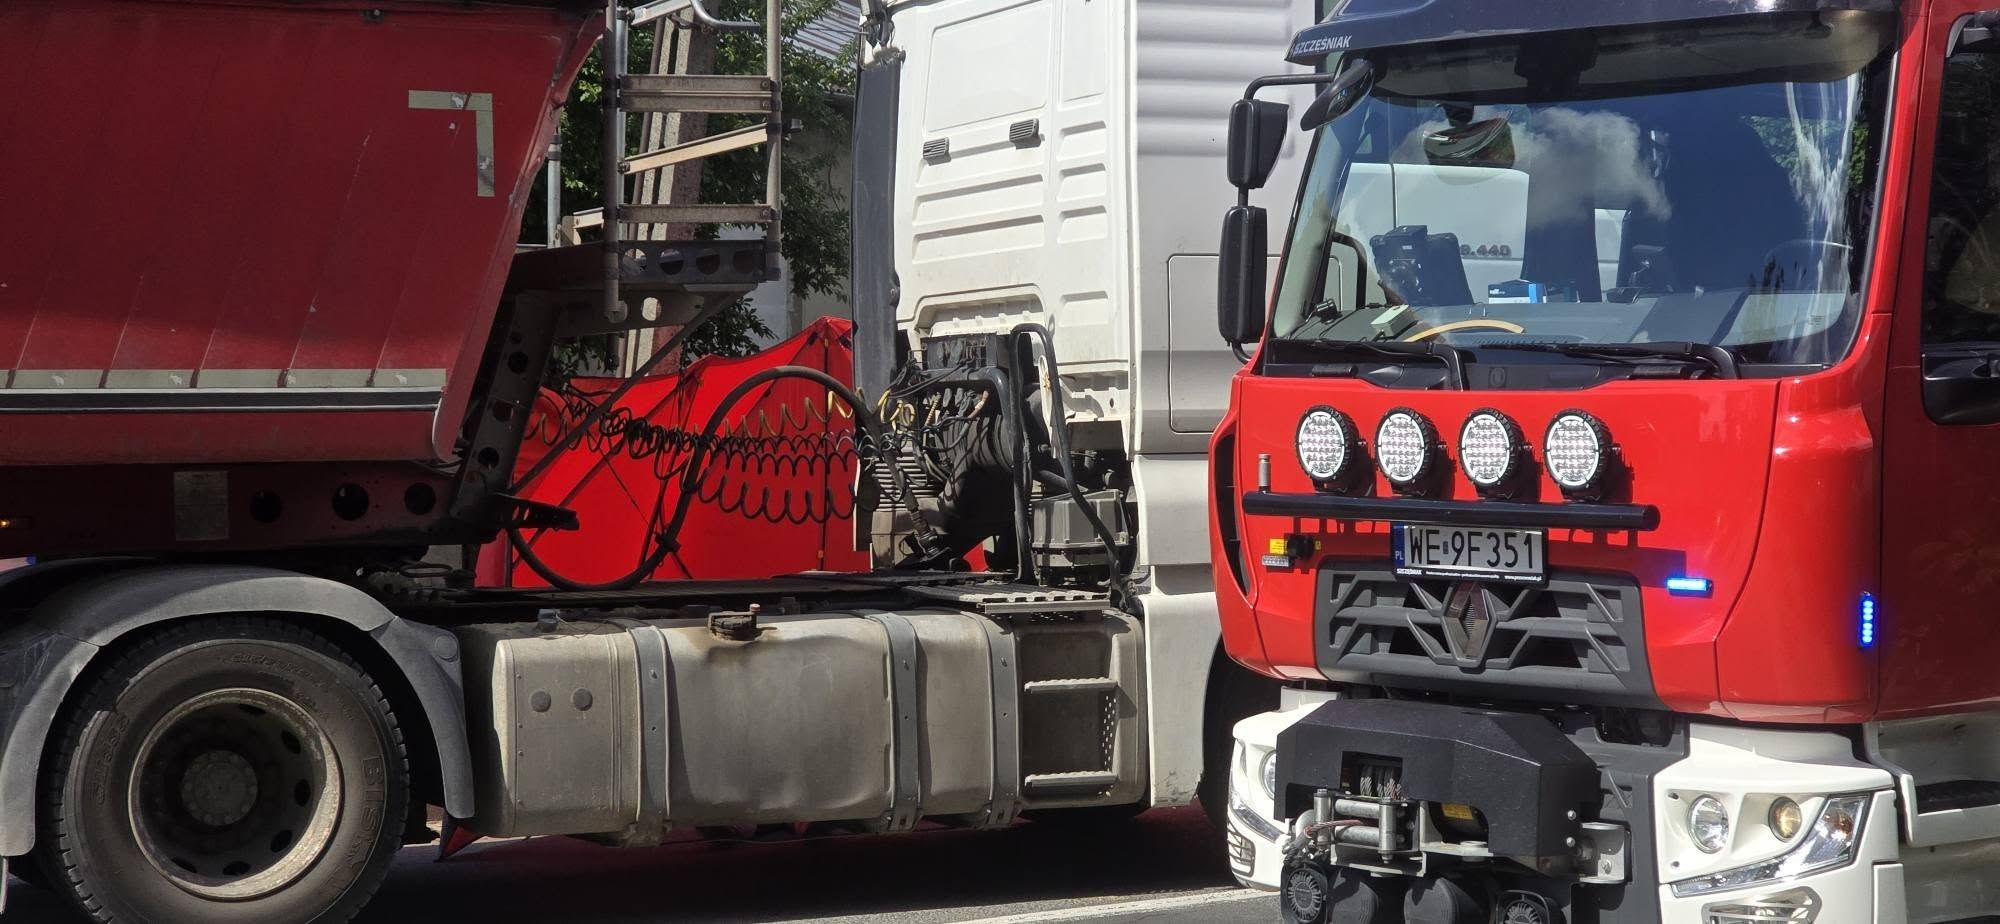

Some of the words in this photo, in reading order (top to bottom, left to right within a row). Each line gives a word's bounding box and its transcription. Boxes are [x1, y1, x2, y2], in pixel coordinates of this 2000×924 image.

[1395, 550, 1404, 561] PL
[1409, 529, 1440, 566] WE
[1451, 531, 1533, 569] 9F351
